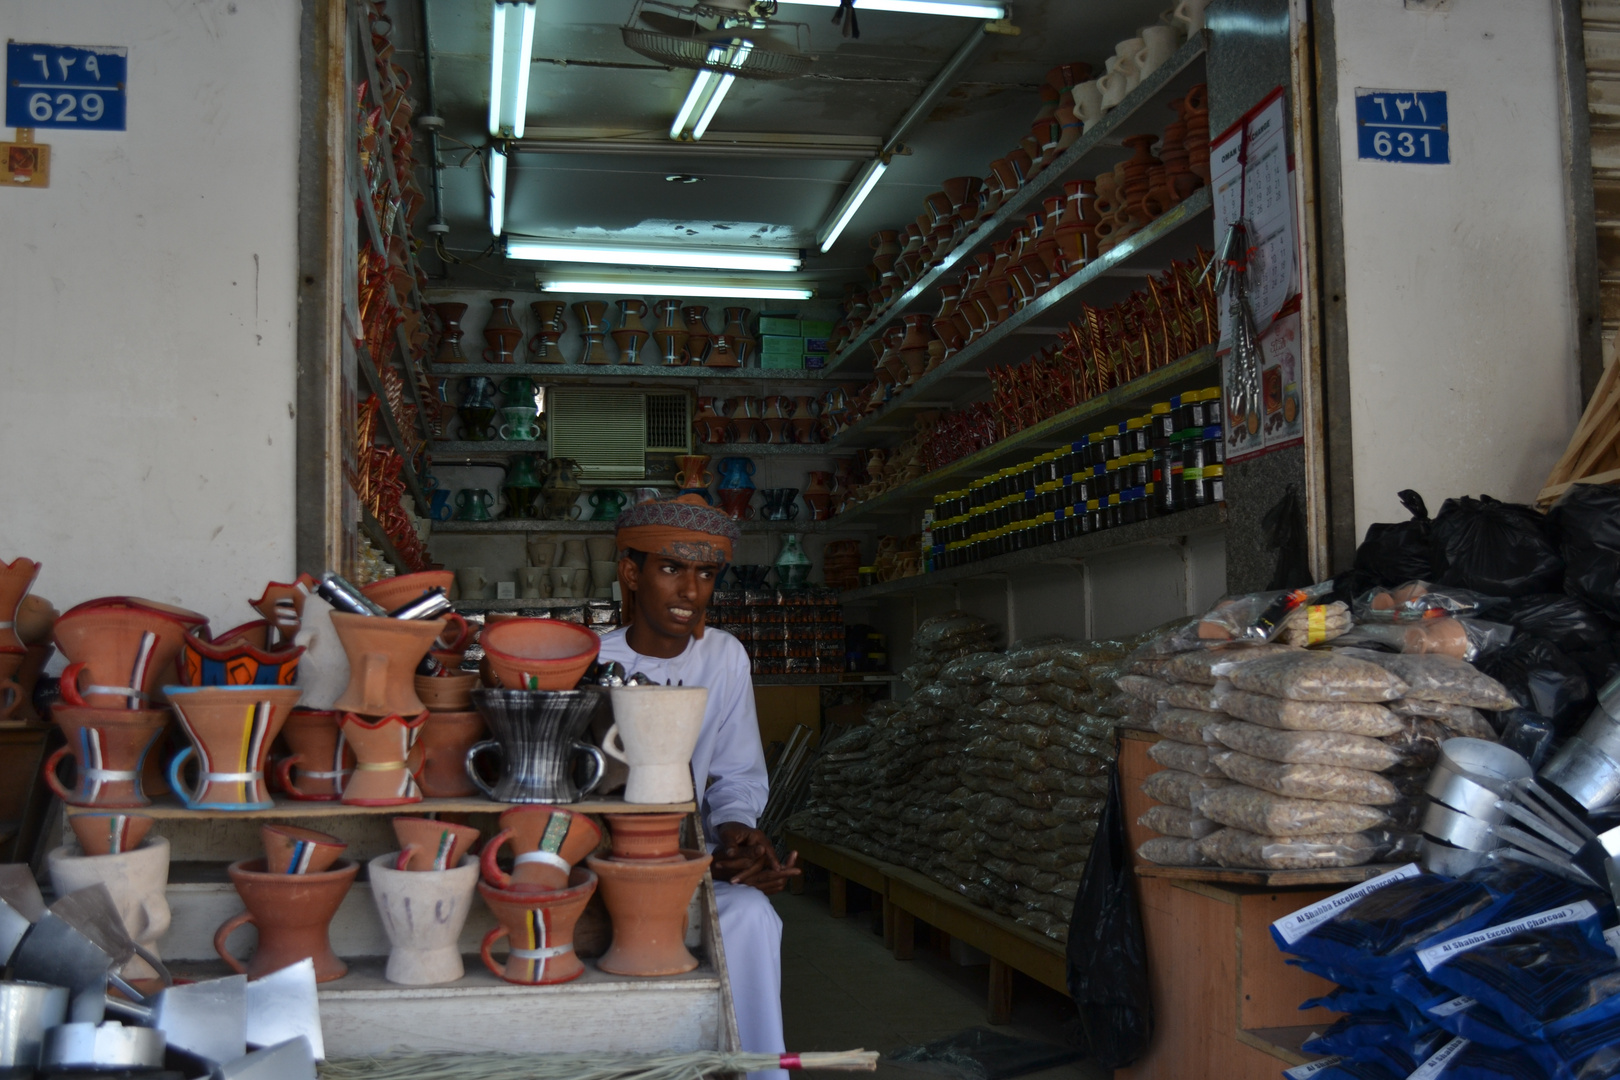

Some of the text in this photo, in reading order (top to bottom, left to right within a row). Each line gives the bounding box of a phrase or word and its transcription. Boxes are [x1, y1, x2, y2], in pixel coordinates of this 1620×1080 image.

[33, 54, 101, 81] ٦٢٩
[29, 92, 104, 122] 629
[1373, 97, 1427, 123] ٦٣١
[1221, 147, 1237, 163] OMAN
[1373, 131, 1431, 158] 631
[1296, 913, 1305, 923] Al
[1304, 903, 1333, 920] Shahba
[1332, 888, 1367, 908] Excellent
[1366, 875, 1399, 894] Charcoal
[1442, 911, 1567, 953] Al Shahba Excellent Charcoal
[1306, 1064, 1315, 1072] Al
[1427, 1060, 1437, 1068] Al
